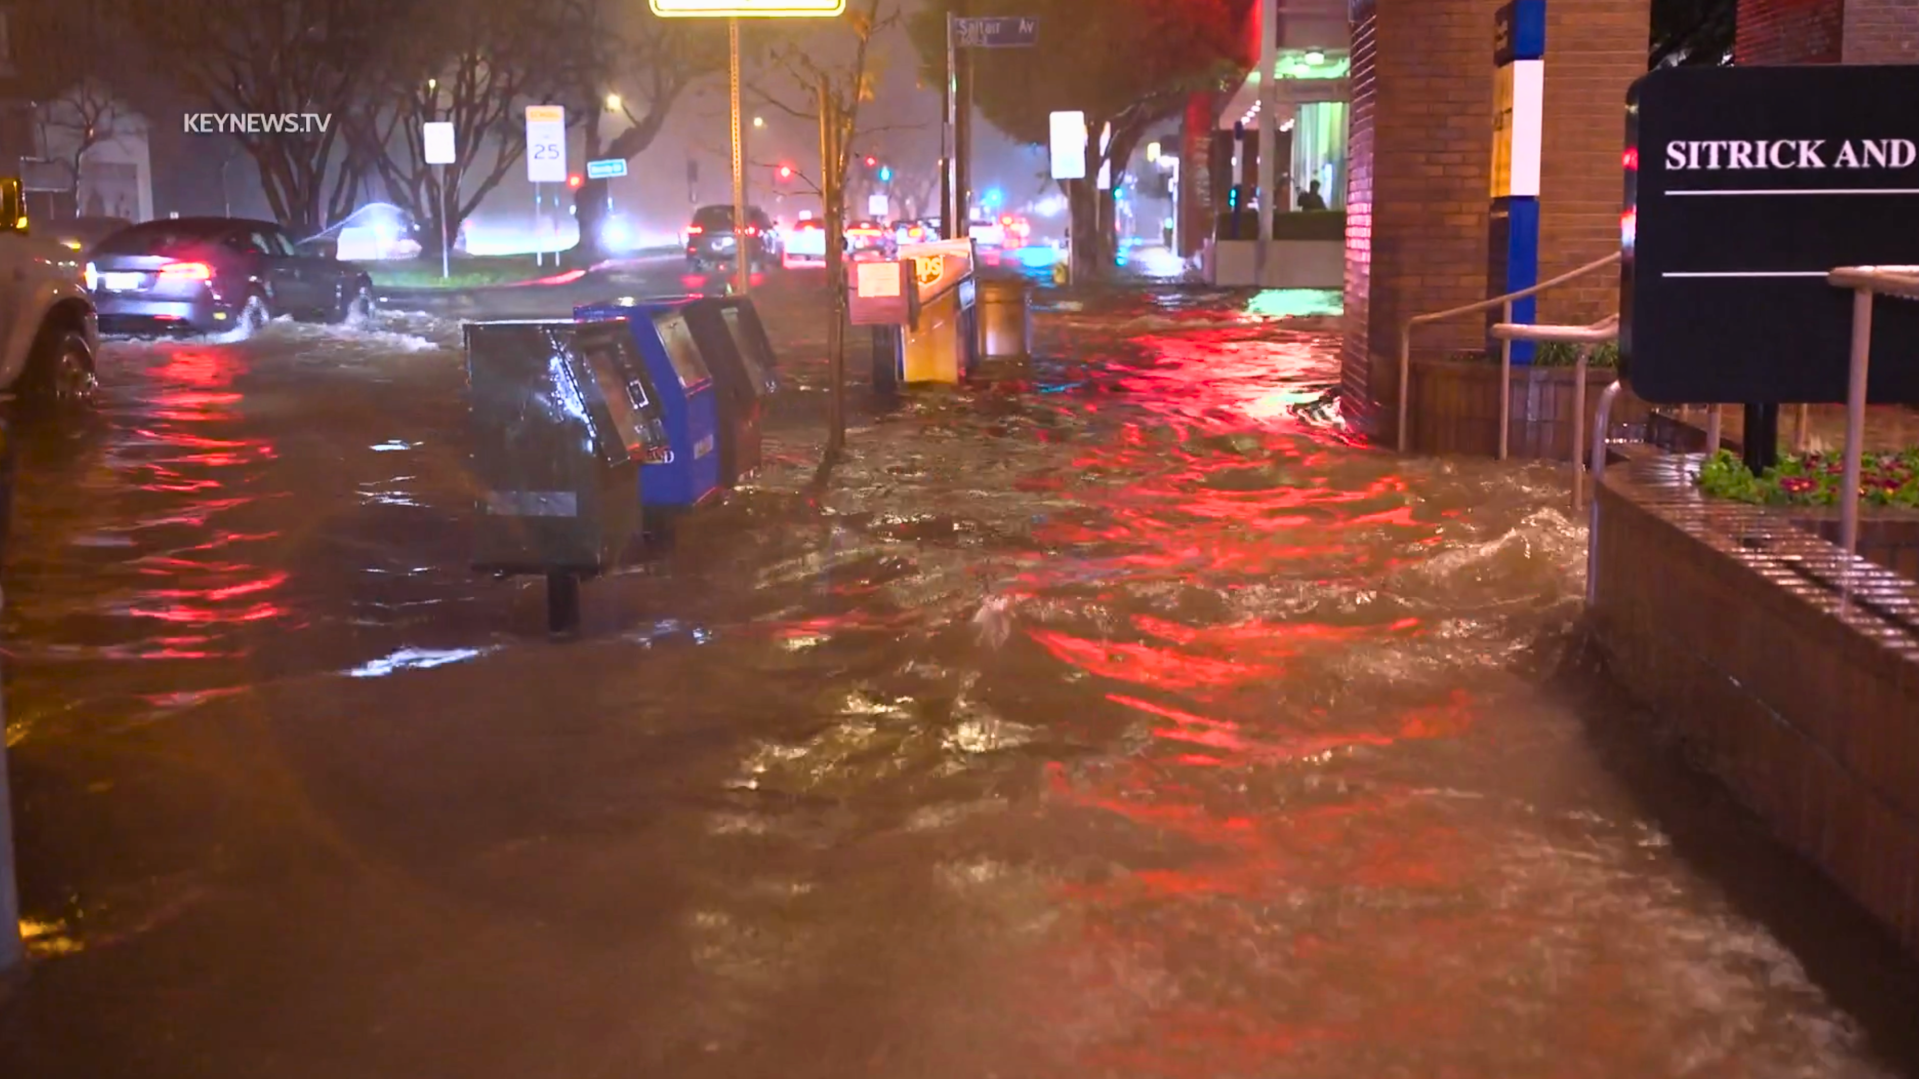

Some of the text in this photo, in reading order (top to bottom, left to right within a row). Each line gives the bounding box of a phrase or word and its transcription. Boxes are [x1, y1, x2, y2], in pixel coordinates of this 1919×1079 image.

[1019, 18, 1034, 33] Av
[534, 144, 560, 160] 25
[1665, 139, 1917, 170] SITRICK AND
